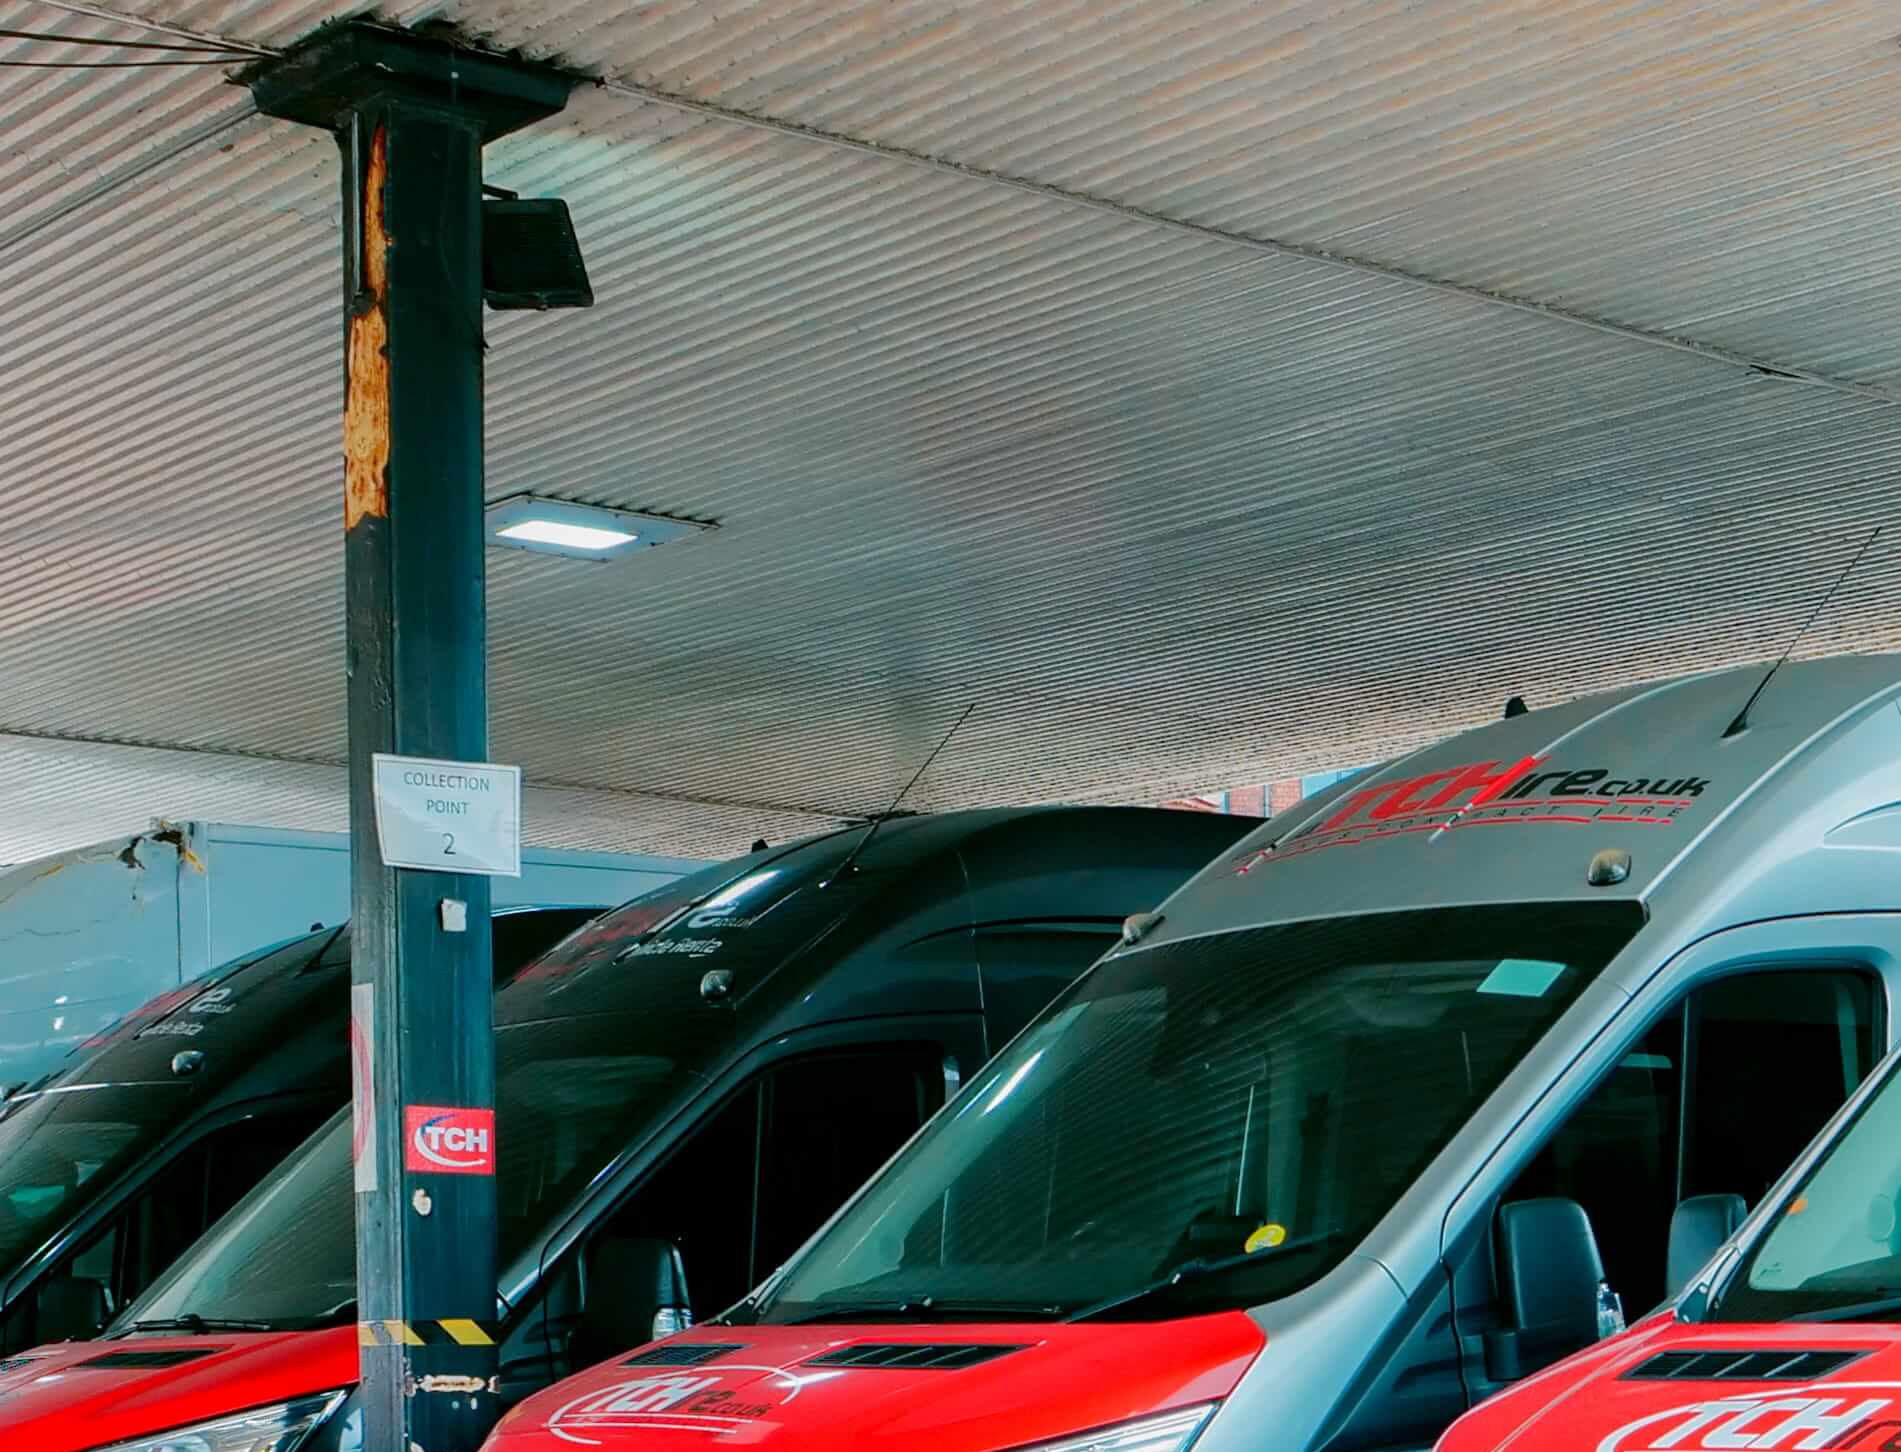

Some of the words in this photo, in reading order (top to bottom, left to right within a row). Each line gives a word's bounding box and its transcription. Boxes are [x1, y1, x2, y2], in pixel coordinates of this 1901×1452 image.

[403, 771, 491, 792] COLLECTION
[426, 799, 470, 815] POINT
[441, 832, 457, 856] 2
[424, 1126, 489, 1153] TCH
